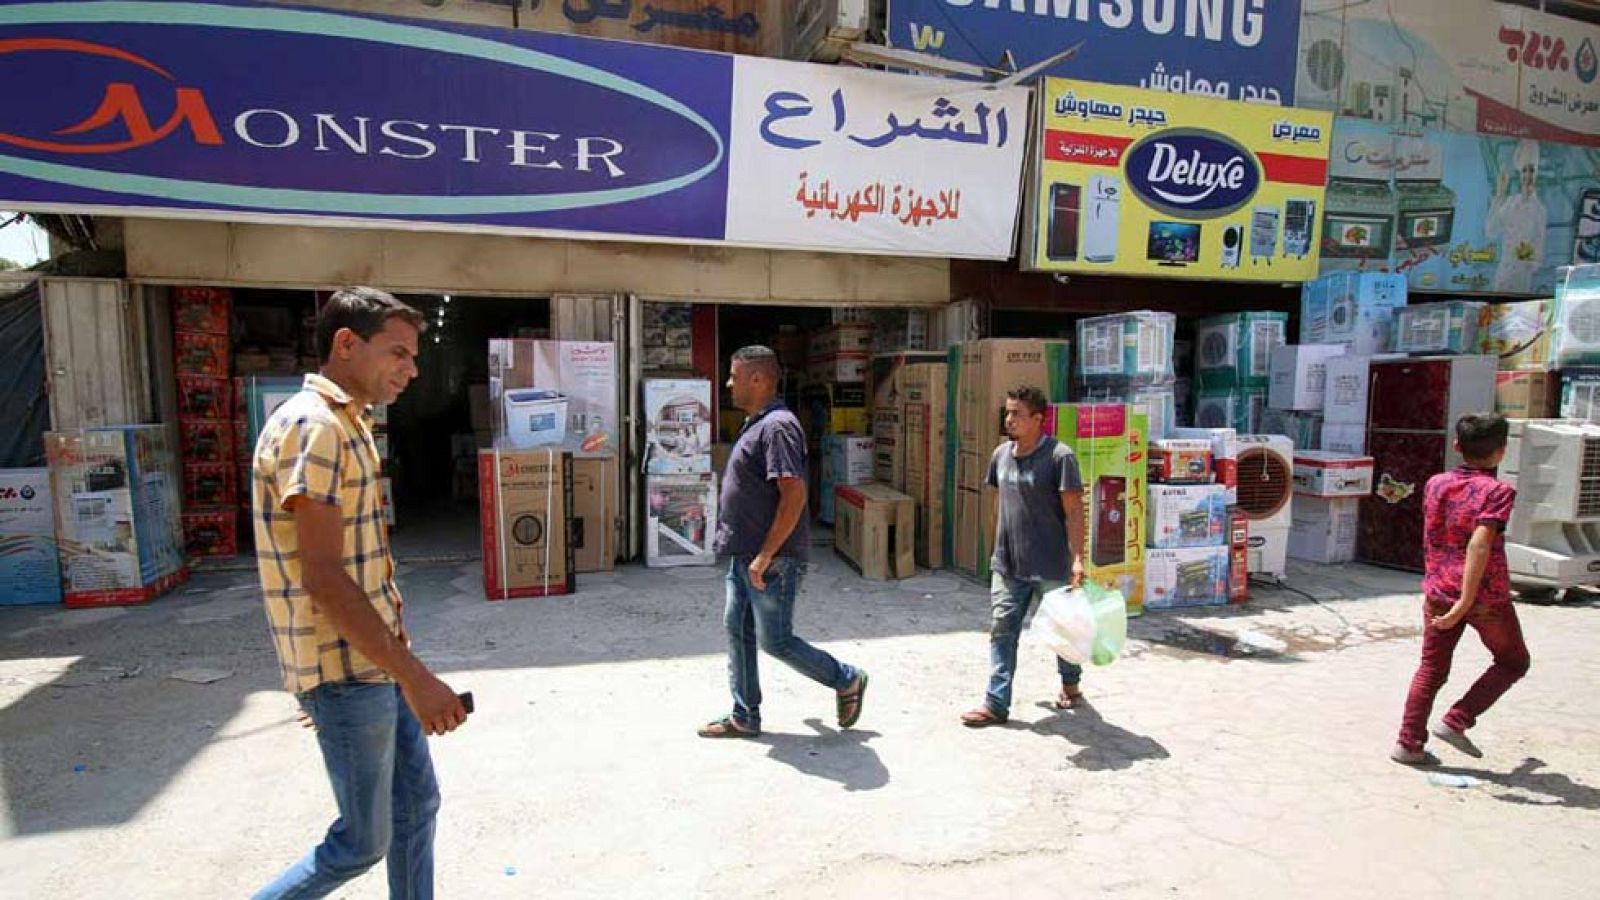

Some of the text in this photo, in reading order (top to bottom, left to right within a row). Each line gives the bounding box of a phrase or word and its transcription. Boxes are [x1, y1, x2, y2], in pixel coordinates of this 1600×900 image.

[946, 0, 1264, 47] SUNG
[52, 83, 625, 178] MONSTER
[760, 87, 1008, 149] الشراع
[1054, 90, 1321, 144] معرض حيدر مهاوش
[1147, 142, 1245, 203] Deluxe
[892, 184, 961, 227] للاجهزة
[1127, 478, 1143, 561] مارشال
